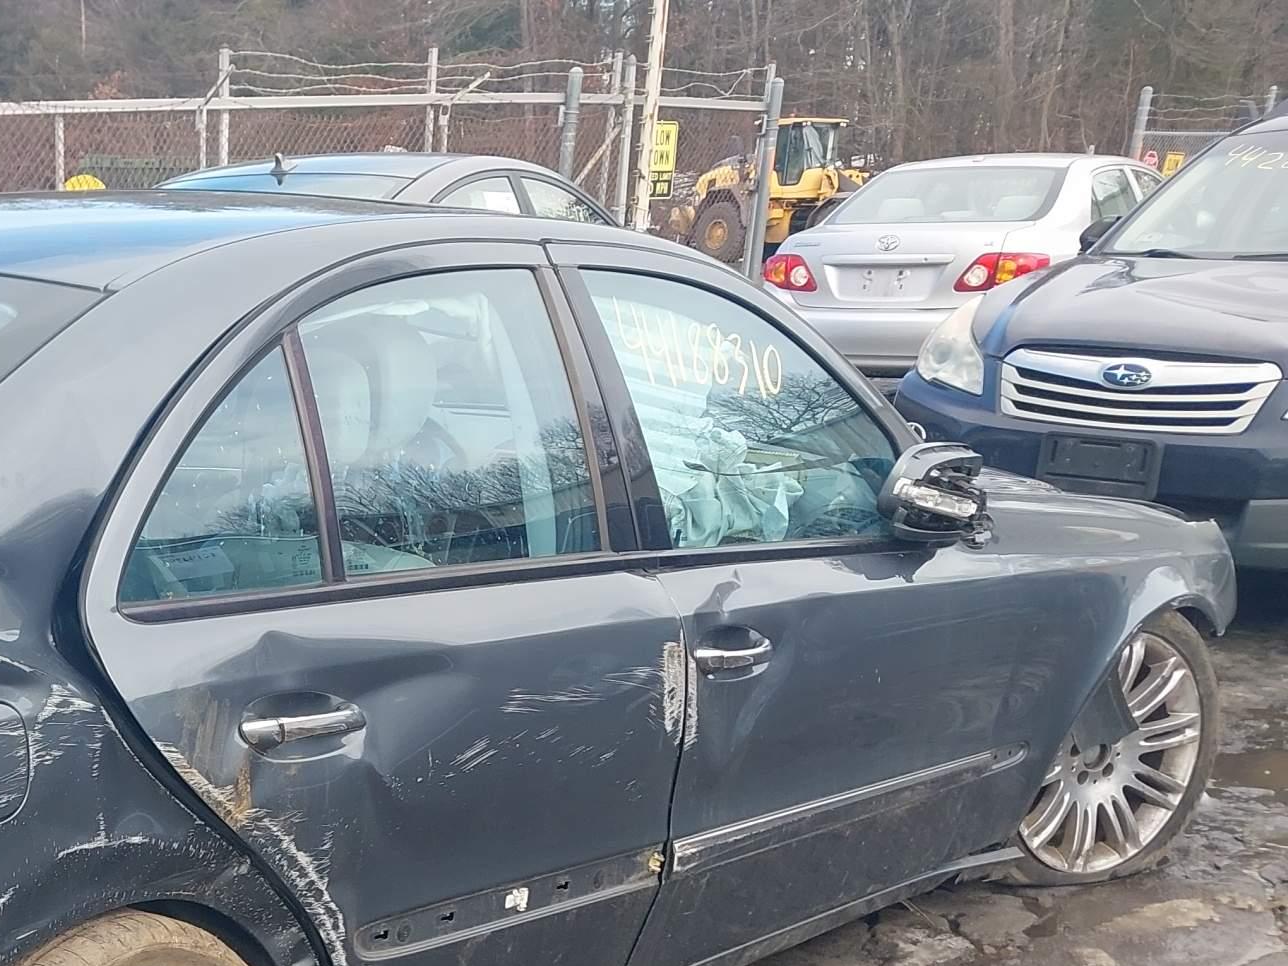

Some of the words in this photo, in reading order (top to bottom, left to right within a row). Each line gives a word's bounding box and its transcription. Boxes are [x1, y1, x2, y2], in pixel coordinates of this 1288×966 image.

[655, 129, 672, 146] LOW
[653, 149, 671, 166] OWN
[612, 295, 782, 399] 44188310
